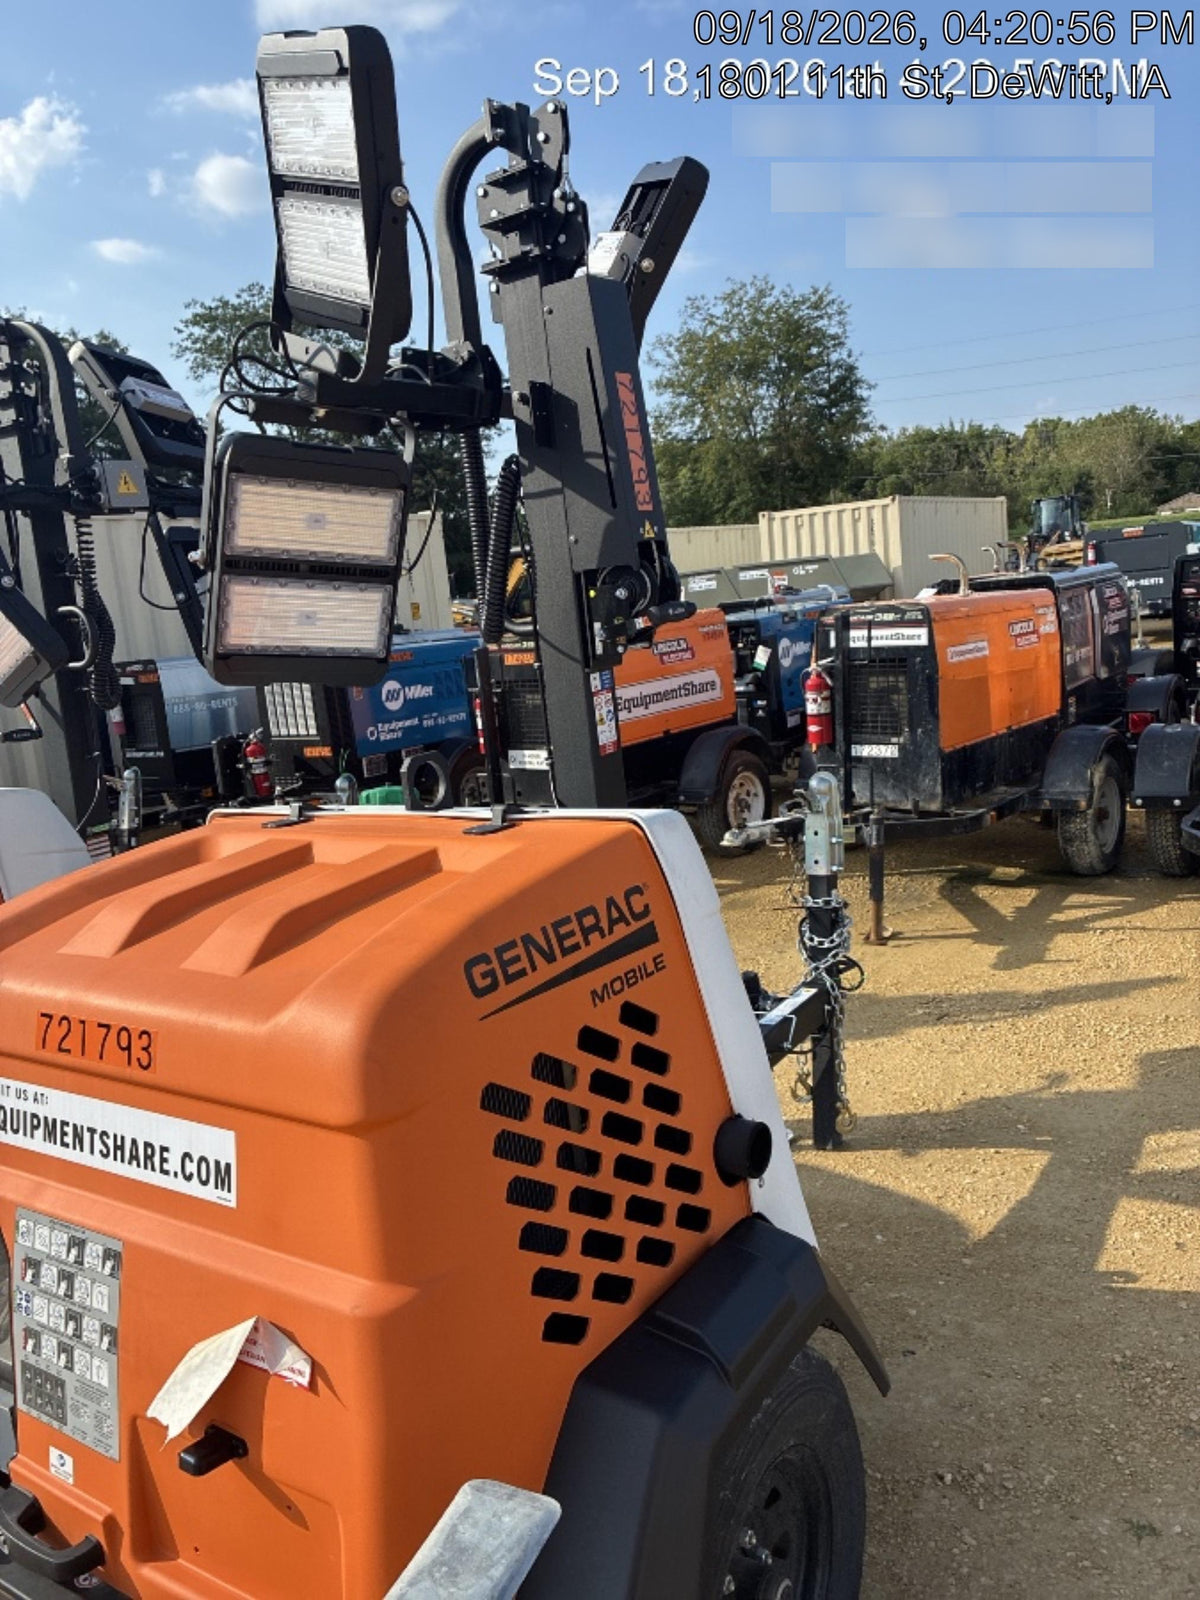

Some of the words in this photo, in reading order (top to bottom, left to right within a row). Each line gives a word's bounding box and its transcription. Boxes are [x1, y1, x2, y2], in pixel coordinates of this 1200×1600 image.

[616, 377, 652, 506] 721793
[616, 680, 717, 713] EquipmentShare
[463, 884, 652, 999] GENERAC
[589, 952, 667, 1008] MOBILE
[40, 1012, 153, 1071] 721793
[15, 1088, 29, 1101] US
[33, 1091, 49, 1106] AT:
[0, 1105, 233, 1194] QUIPMENTSHARE.COM
